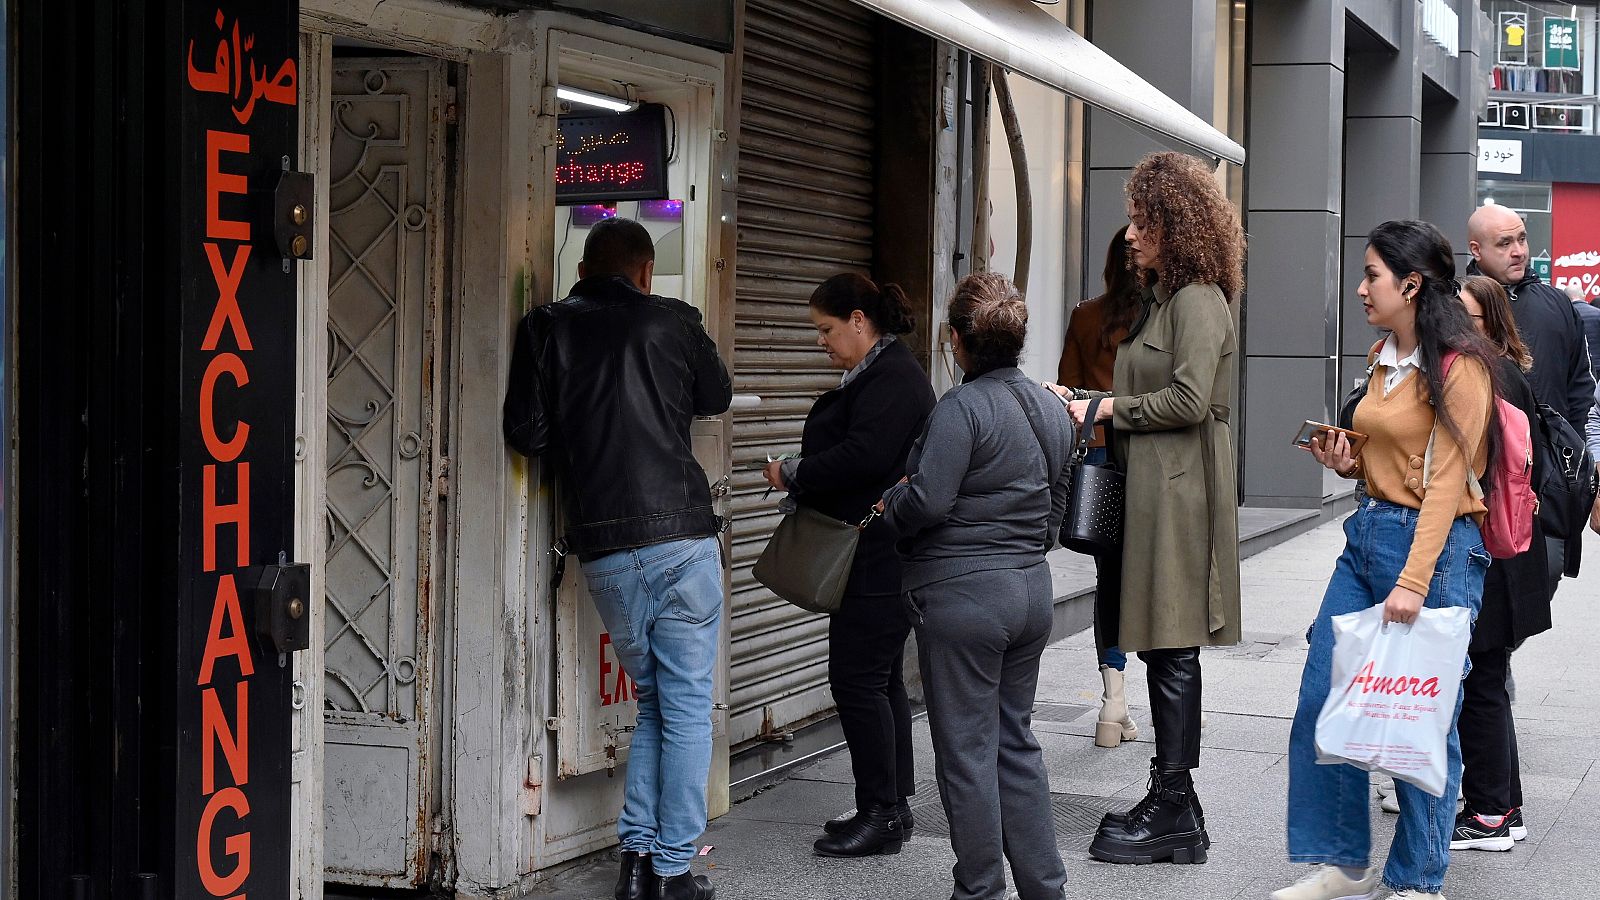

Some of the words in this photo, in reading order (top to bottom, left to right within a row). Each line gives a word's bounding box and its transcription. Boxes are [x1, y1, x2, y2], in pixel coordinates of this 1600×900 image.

[556, 158, 644, 185] change
[197, 130, 254, 900] EXCHANG
[1344, 660, 1442, 698] Amora
